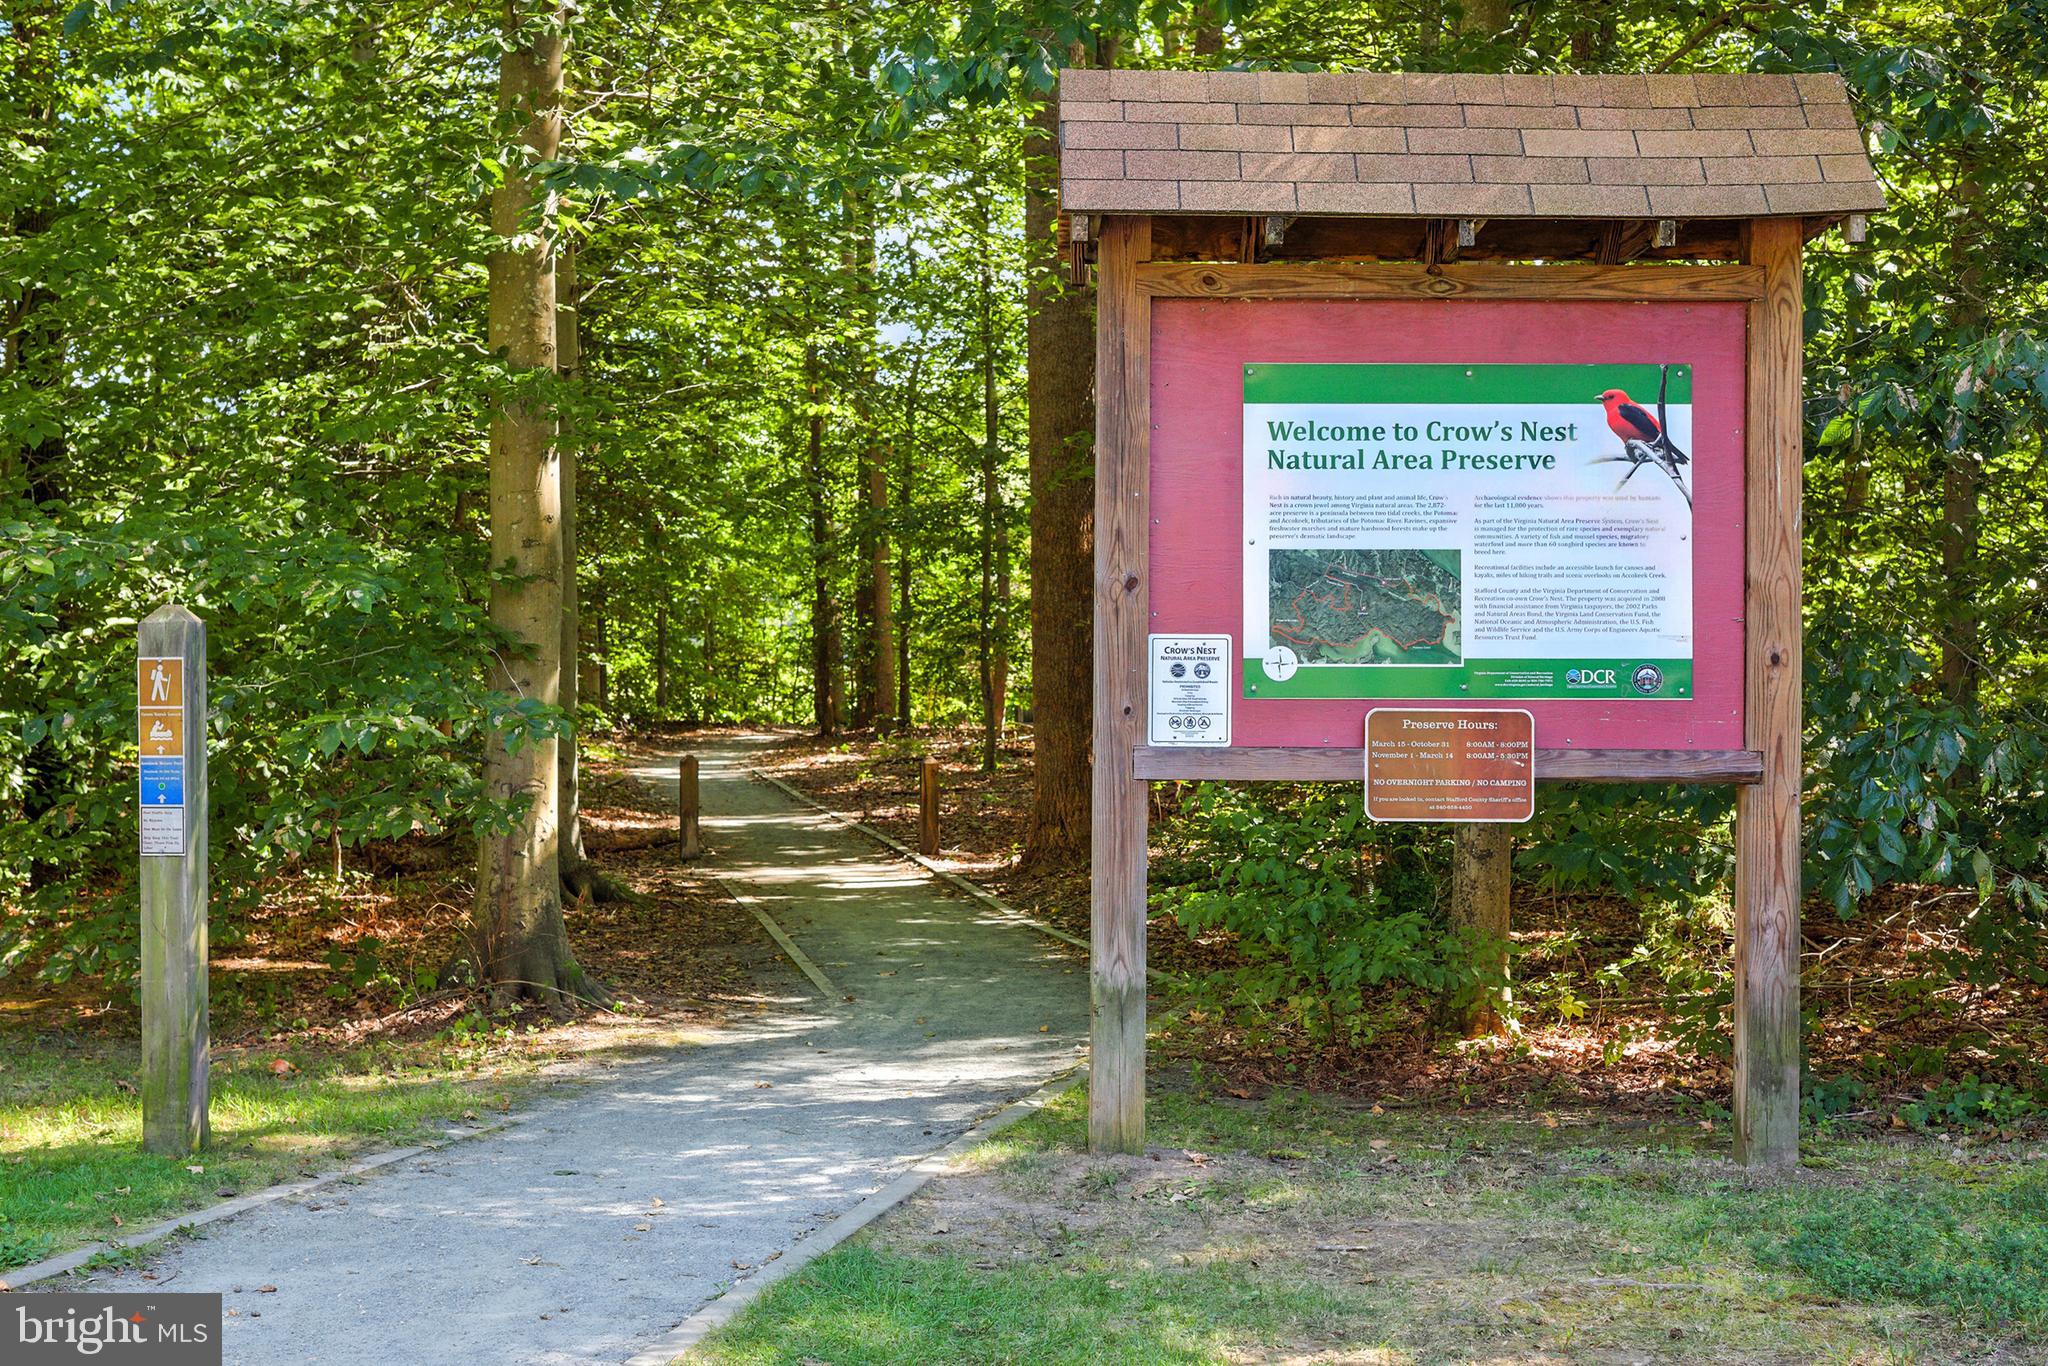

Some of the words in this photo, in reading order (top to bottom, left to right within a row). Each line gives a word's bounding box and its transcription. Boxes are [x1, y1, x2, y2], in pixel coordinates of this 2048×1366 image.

[1267, 421, 1386, 441] Welcome
[1391, 423, 1419, 441] to
[1426, 421, 1513, 441] Crow’s
[1520, 421, 1578, 441] Nest
[1268, 449, 1365, 470] Natural
[1371, 449, 1434, 470] Area
[1441, 449, 1556, 470] Preserve
[1196, 646, 1217, 655] NEST
[1580, 669, 1617, 684] DCR
[1402, 719, 1454, 729] Preserve
[1457, 719, 1498, 729] Hours:
